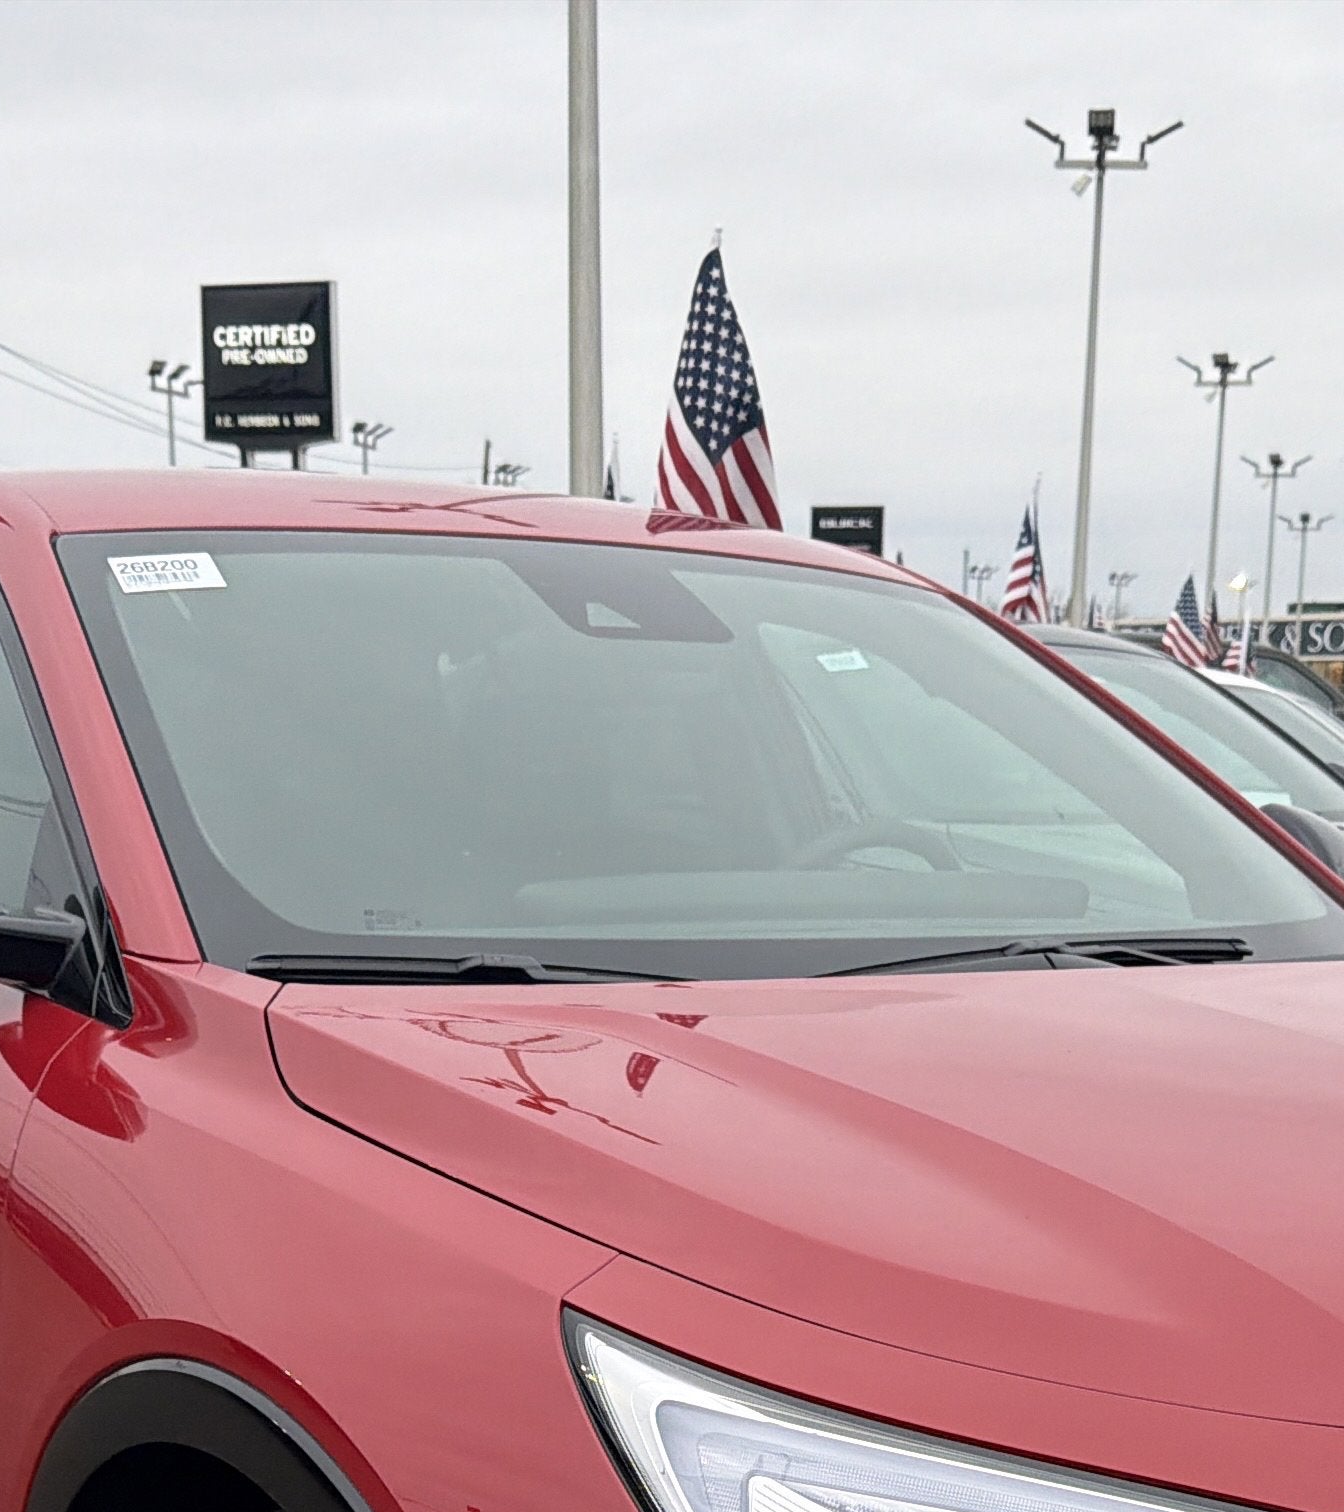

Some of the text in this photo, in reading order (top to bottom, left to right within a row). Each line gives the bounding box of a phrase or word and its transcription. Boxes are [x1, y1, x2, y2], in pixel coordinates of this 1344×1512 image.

[213, 323, 316, 348] CERTIFIED
[221, 347, 308, 366] PRE-OWNED
[117, 559, 198, 575] 26B200
